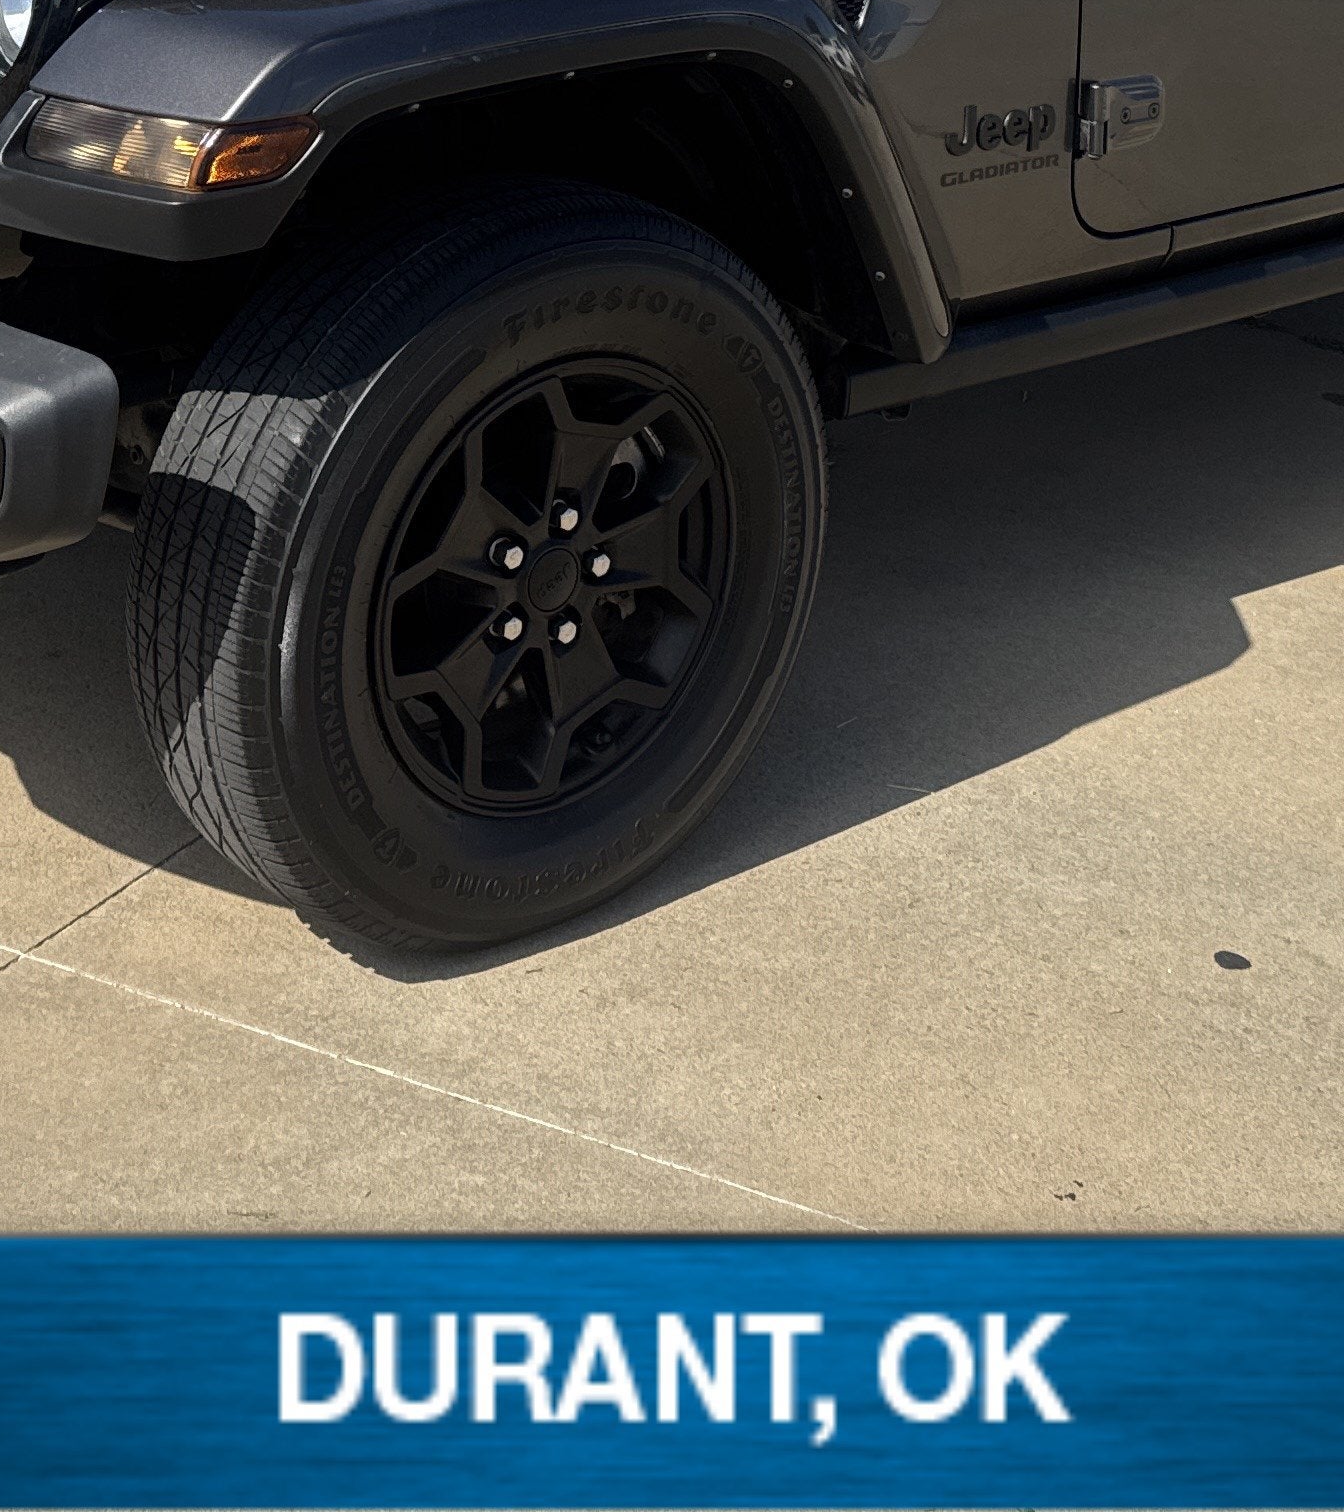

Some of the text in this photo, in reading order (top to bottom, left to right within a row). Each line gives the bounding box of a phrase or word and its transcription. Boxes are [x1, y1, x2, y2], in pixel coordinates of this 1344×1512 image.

[945, 104, 1056, 157] Jeep
[940, 154, 1059, 187] GLADIATOR
[502, 284, 718, 349] Firestone
[766, 395, 802, 576] DESTINATION
[319, 605, 367, 811] DESTINATION
